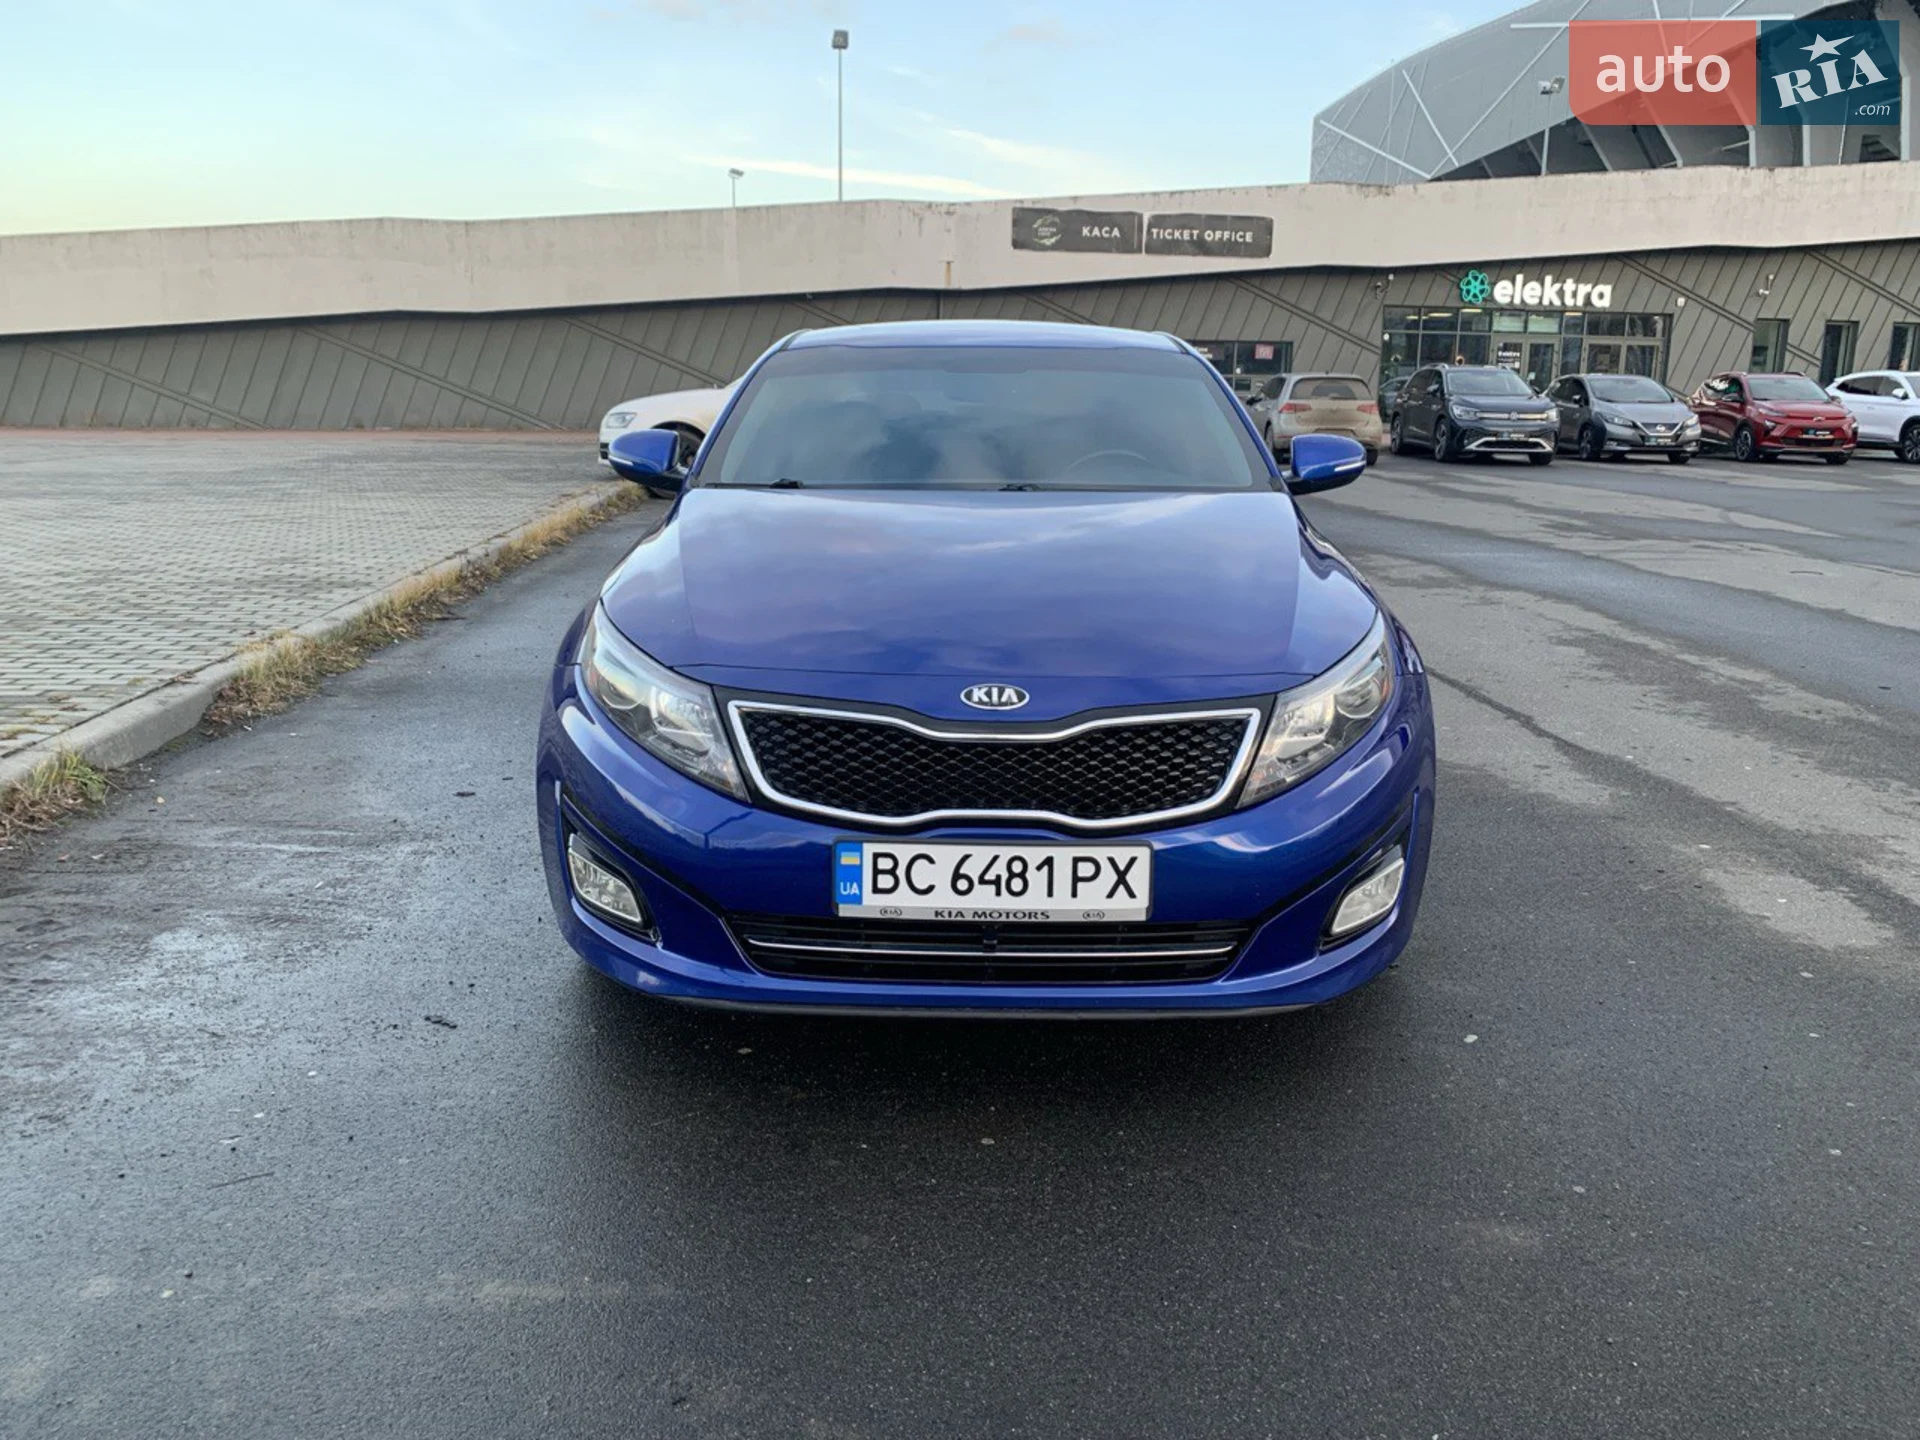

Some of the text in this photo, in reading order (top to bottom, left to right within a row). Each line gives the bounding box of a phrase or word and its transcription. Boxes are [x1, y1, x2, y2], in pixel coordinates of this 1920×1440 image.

[1082, 226, 1121, 238] КАСА
[1151, 228, 1253, 242] TICKET OFFICE
[1493, 274, 1612, 308] elektra
[972, 687, 1018, 705] KIA
[871, 852, 1138, 899] BC 6481 PX
[840, 881, 860, 895] UA
[934, 909, 1050, 920] KIA MOTORS
